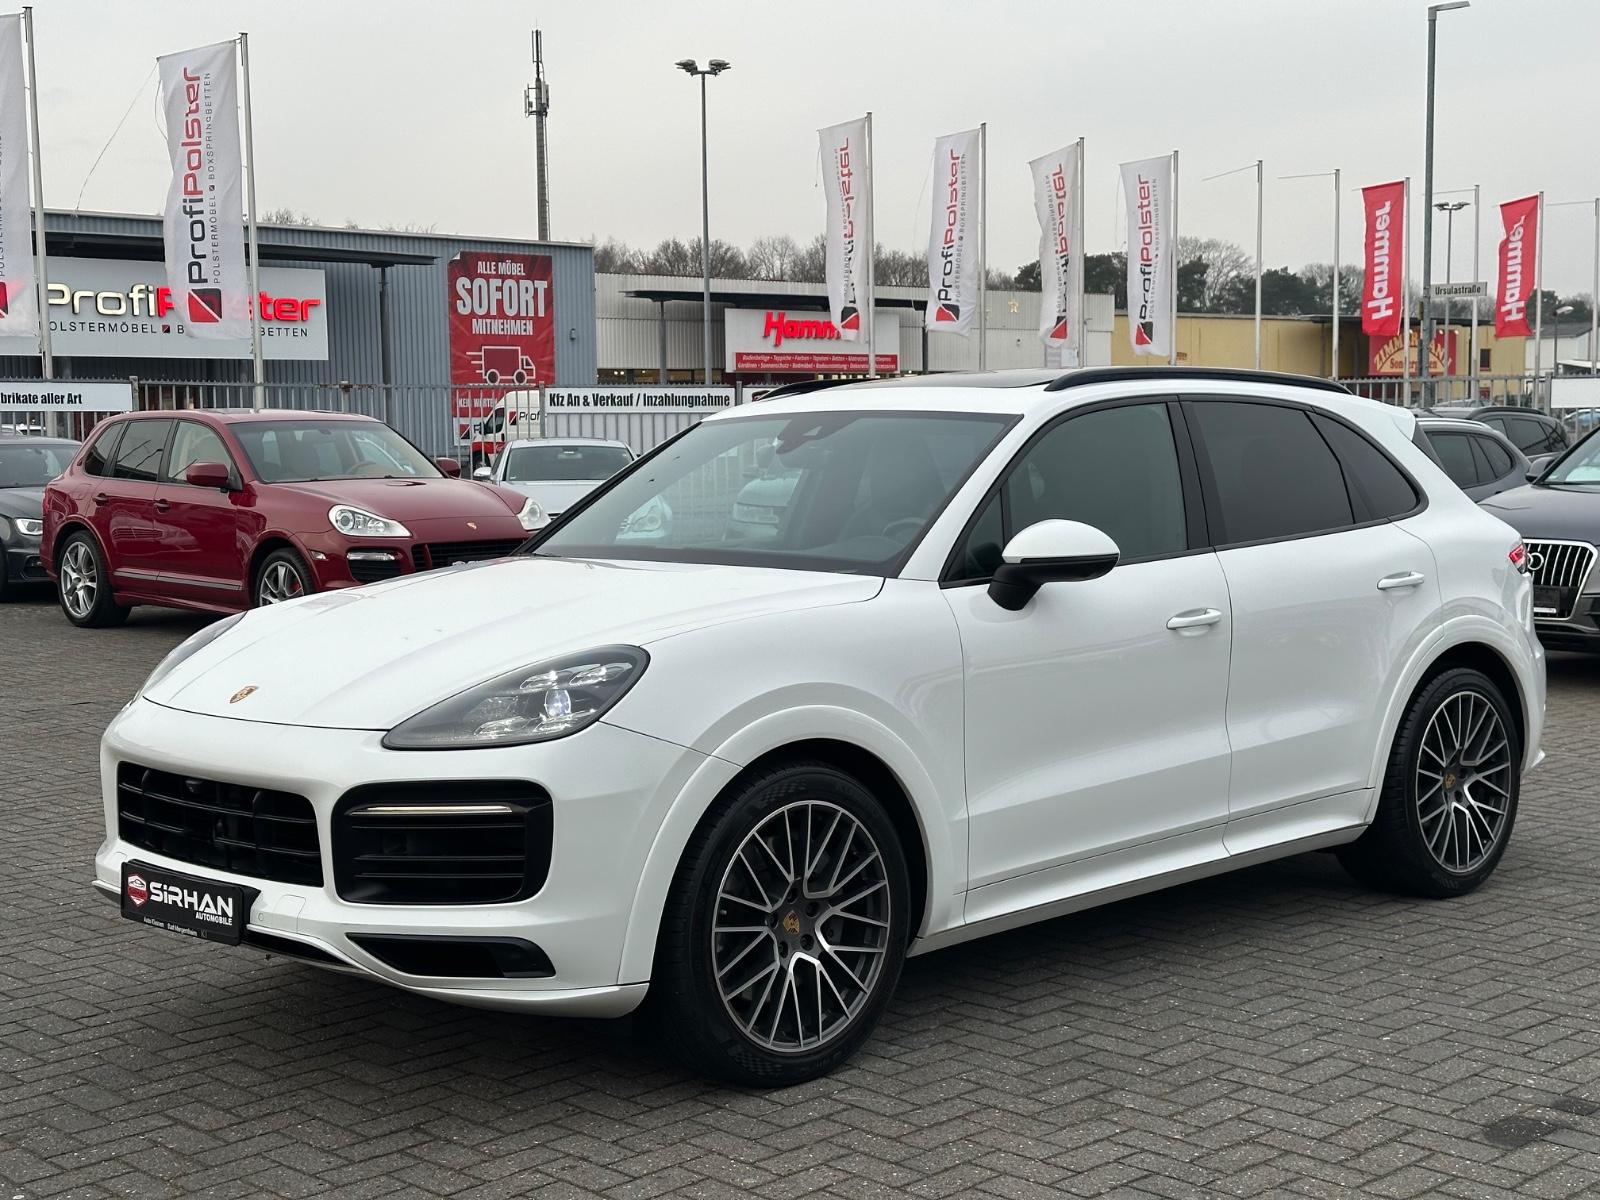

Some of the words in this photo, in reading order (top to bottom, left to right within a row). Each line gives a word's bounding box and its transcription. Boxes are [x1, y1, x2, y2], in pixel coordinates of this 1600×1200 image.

[203, 73, 215, 180] BOXSPRINGBETTEN
[181, 67, 208, 283] ProfiPolster
[938, 148, 960, 302] ProfiPolster
[1138, 174, 1153, 320] ProfiPolster
[1367, 200, 1394, 320] Hammer
[477, 261, 496, 274] ALLE
[498, 260, 525, 275] MÖBEL
[1500, 215, 1526, 321] Hammer
[456, 276, 547, 317] SOFORT
[1434, 284, 1481, 295] Ursulastraße
[49, 320, 157, 334] OLSTERMÖBEL
[472, 319, 533, 335] MITNEHMEN
[763, 311, 842, 347] Hamm
[41, 392, 65, 404] aller
[67, 393, 82, 404] Art
[549, 393, 565, 407] Kfz
[567, 393, 580, 407] An
[582, 394, 591, 407] &
[592, 392, 634, 407] Verkauf
[635, 393, 641, 407] /
[643, 393, 730, 408] Inzahlungnahme
[195, 912, 233, 926] AUTOMOBILE
